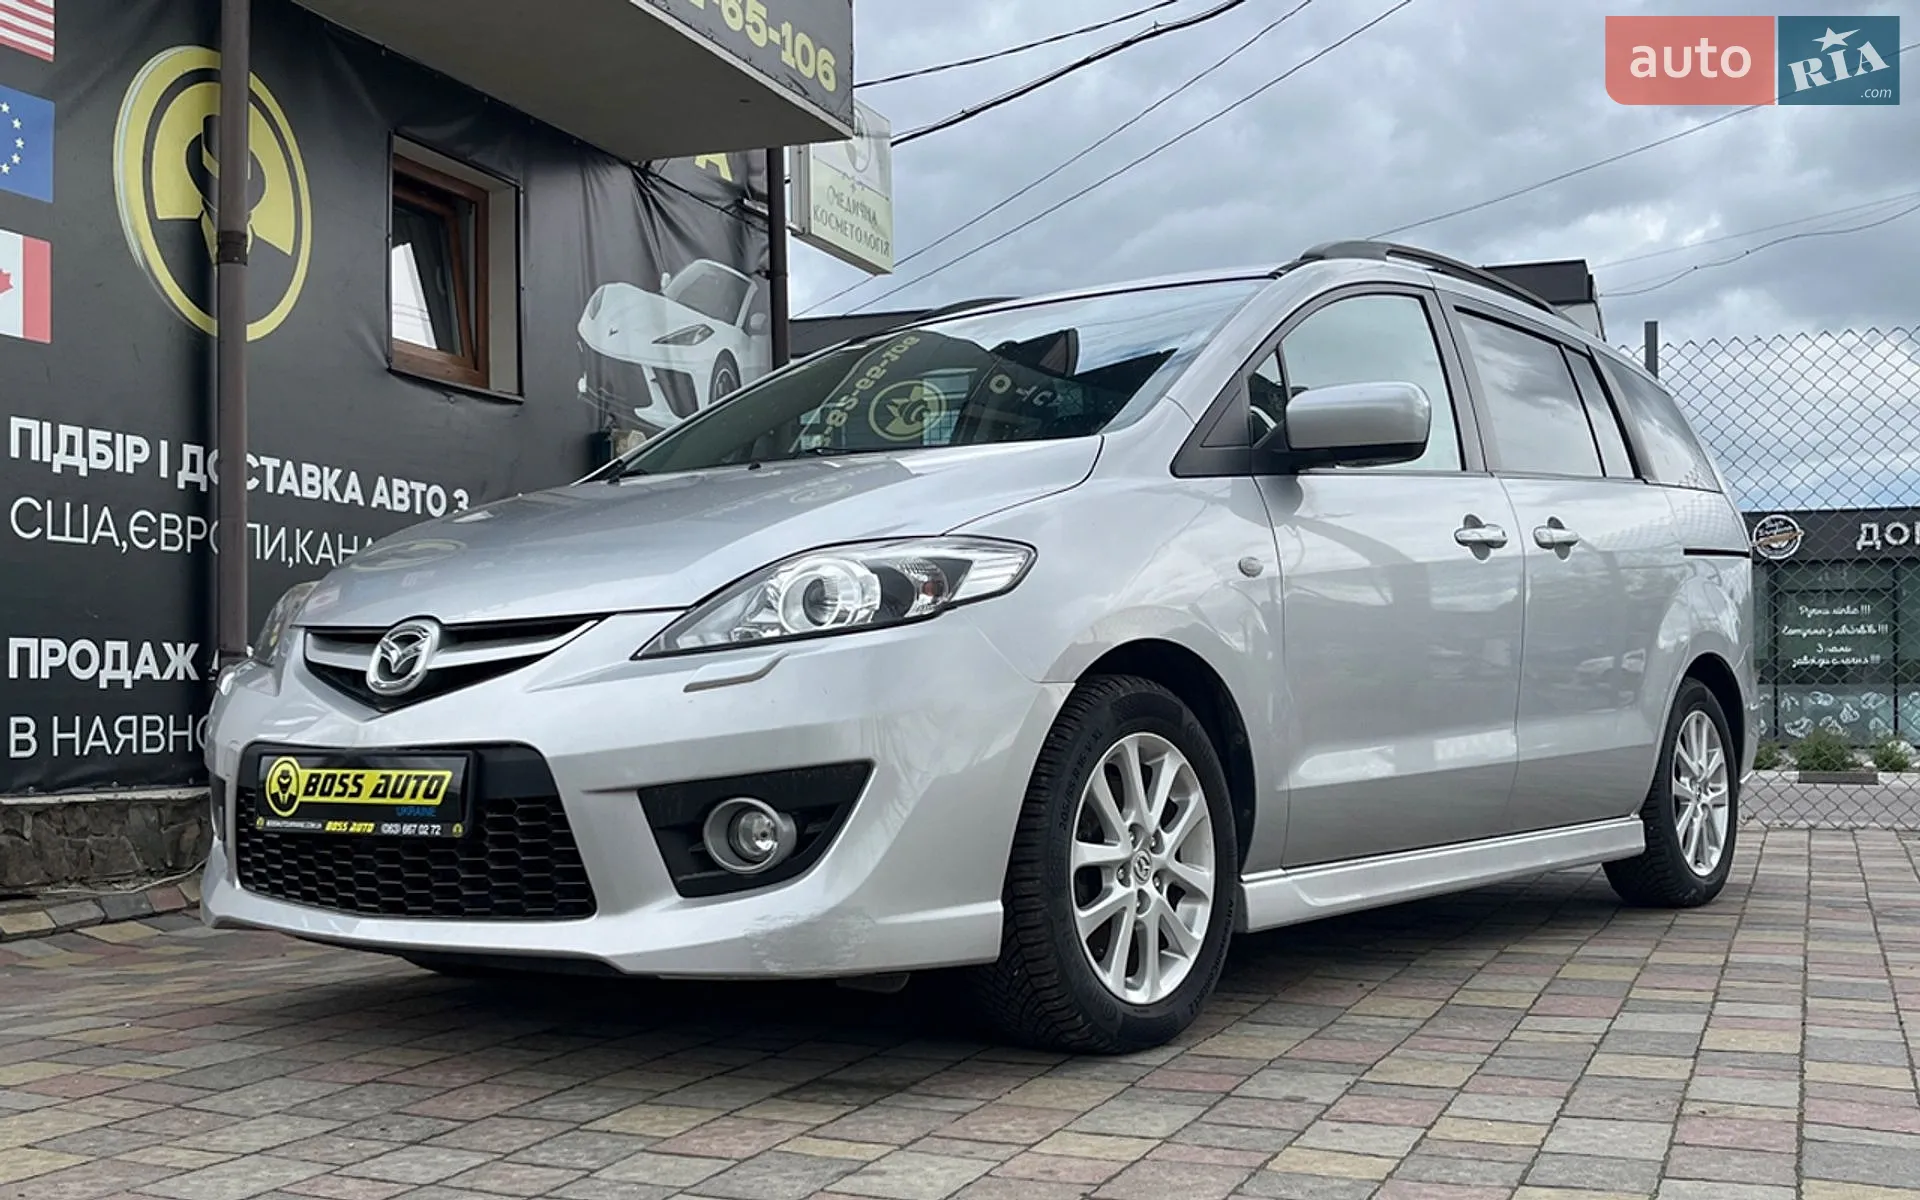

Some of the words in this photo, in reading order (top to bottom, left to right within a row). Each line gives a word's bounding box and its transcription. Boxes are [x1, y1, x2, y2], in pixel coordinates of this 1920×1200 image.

[689, 0, 837, 92] 65-106
[813, 205, 891, 258] КОСМЕТОЛОГІЯ
[9, 417, 150, 476] ПІДБІР
[371, 476, 447, 517] АВТО
[10, 496, 376, 569] США,ЄВРПИ,КАН
[1856, 521, 1920, 551] ДО
[8, 637, 200, 689] ПРОДАЖ
[9, 716, 38, 759] В
[303, 773, 365, 798] BOSS
[369, 773, 446, 800] AUTO
[325, 821, 349, 832] BOSS
[349, 822, 375, 833] AUTO
